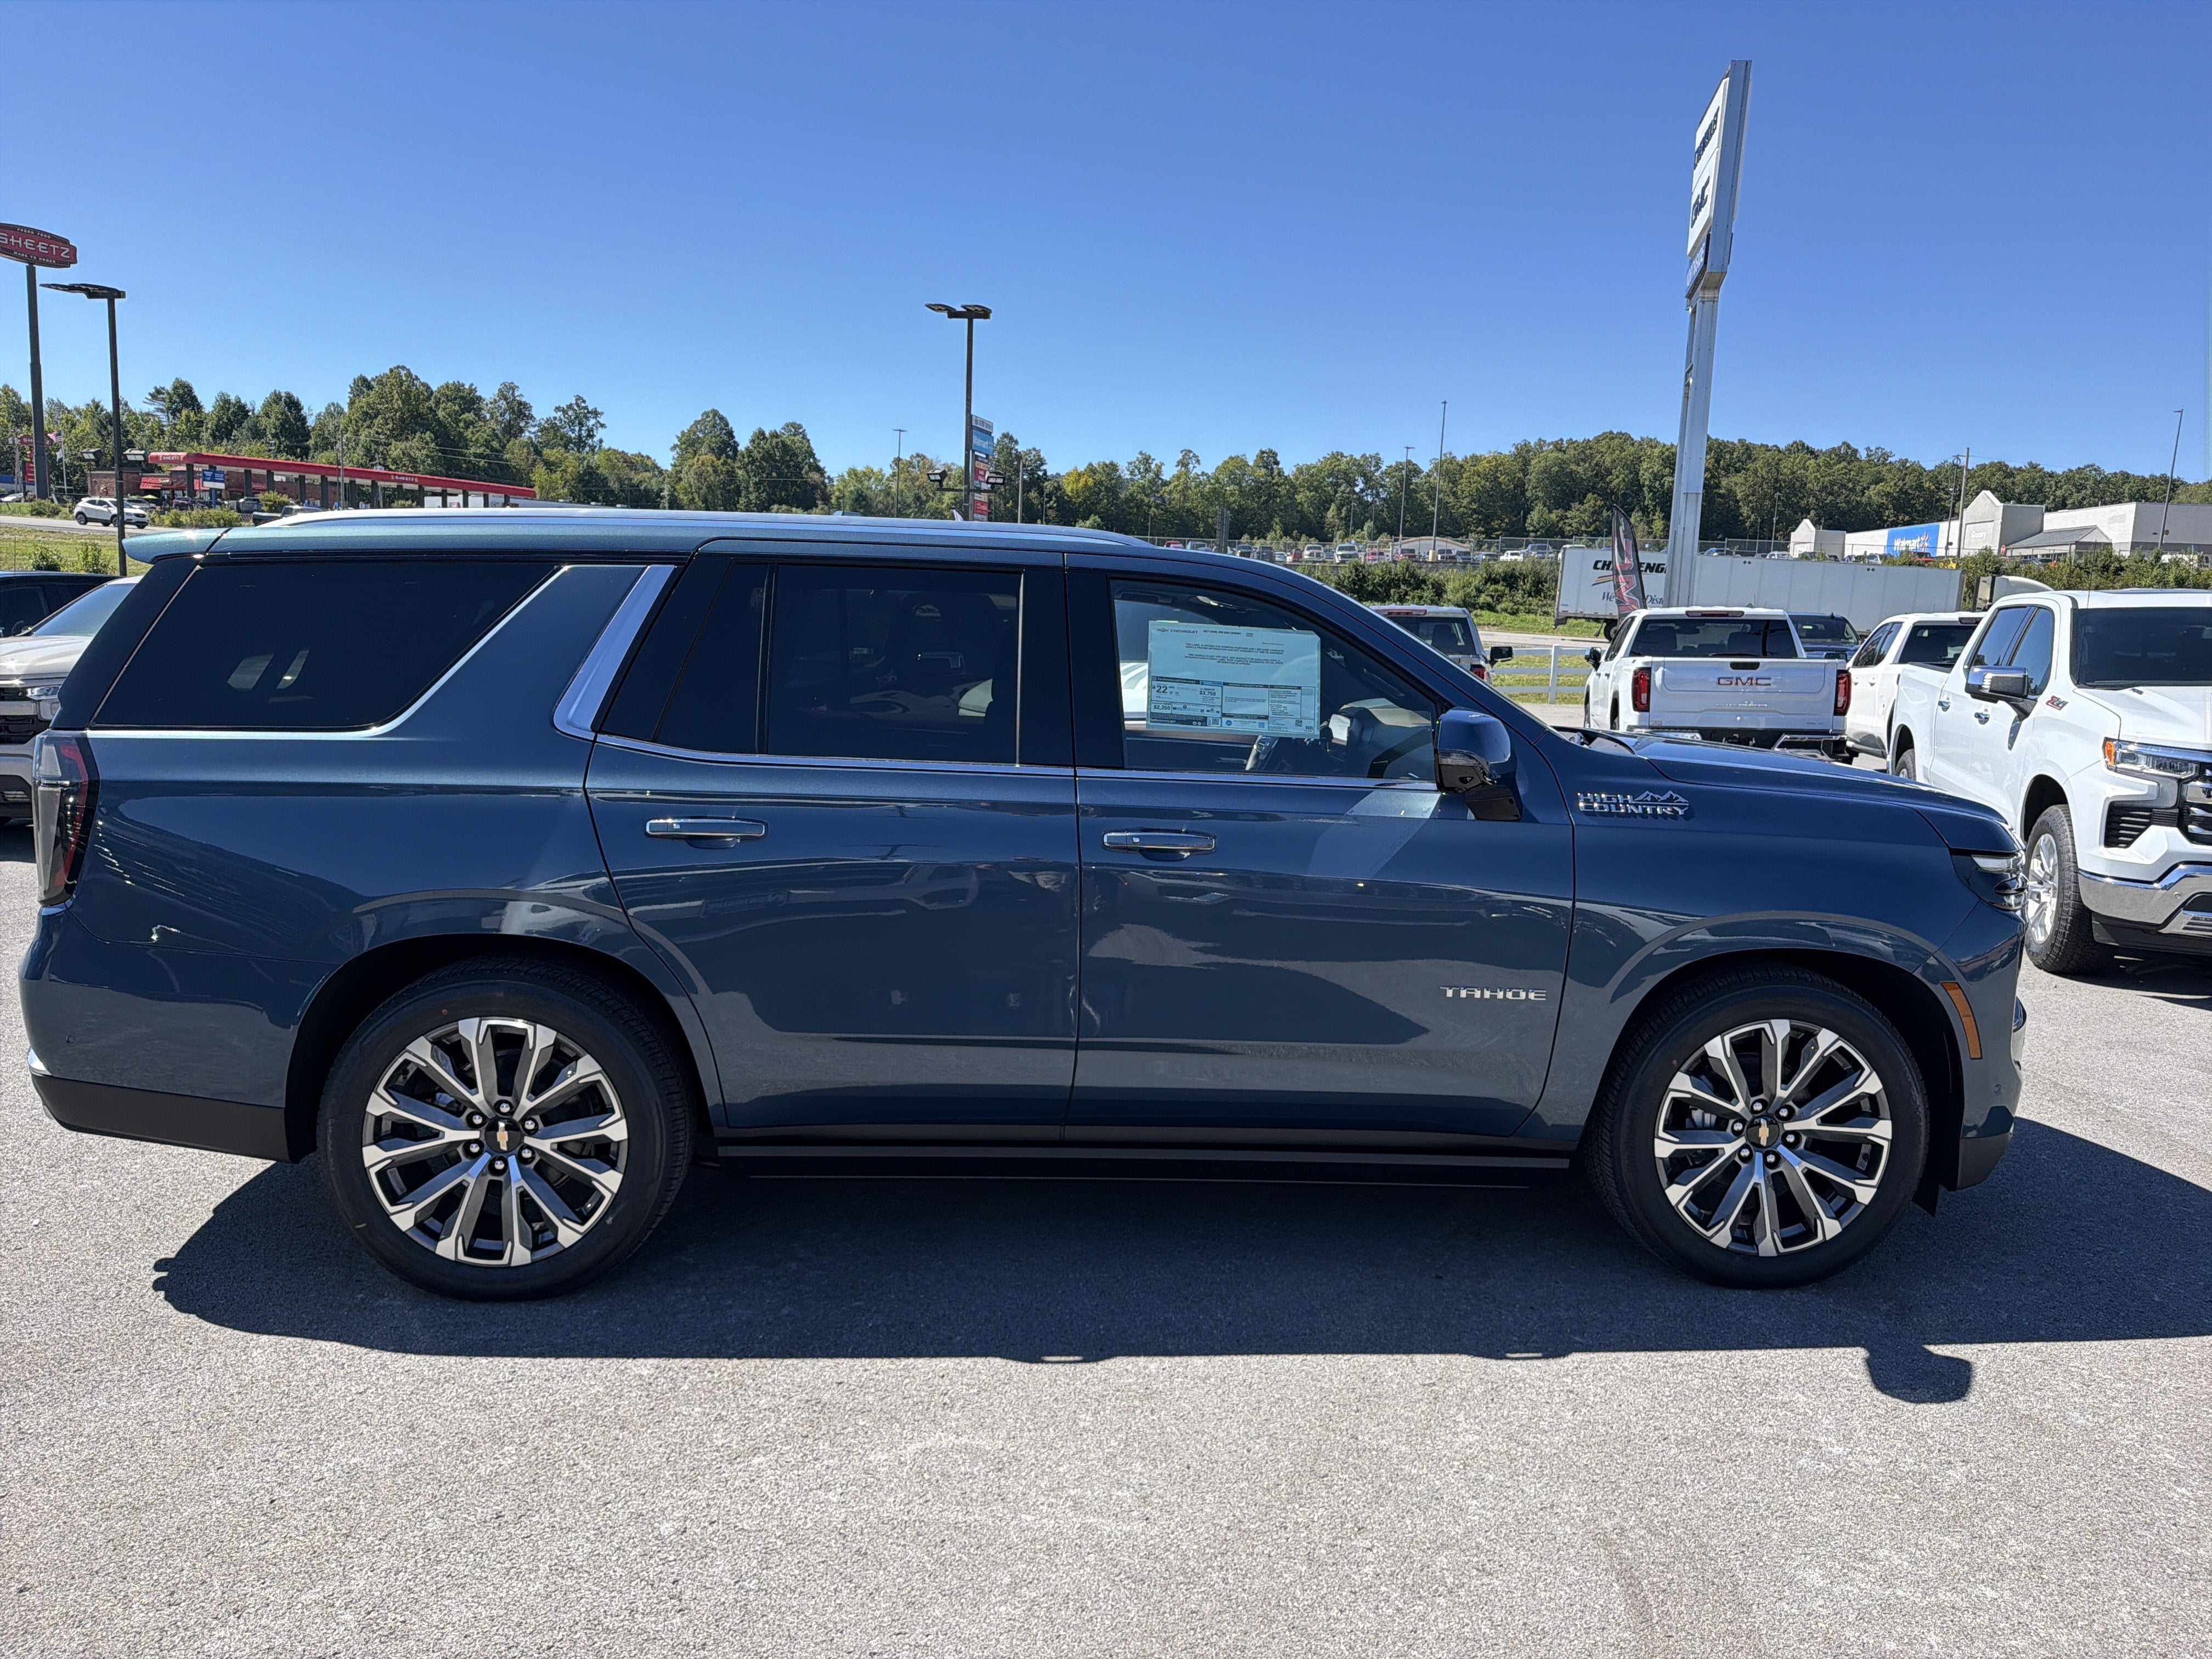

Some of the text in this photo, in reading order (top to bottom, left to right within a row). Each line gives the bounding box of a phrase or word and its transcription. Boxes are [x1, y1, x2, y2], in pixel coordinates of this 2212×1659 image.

[0, 232, 70, 258] SHEETZ
[1894, 536, 1920, 551] Walmart
[1602, 591, 1615, 601] We
[1717, 677, 1771, 686] GMC
[1577, 793, 1634, 803] HIGH
[1579, 802, 1689, 815] COUNTRY
[1440, 986, 1547, 1000] TAHOE
